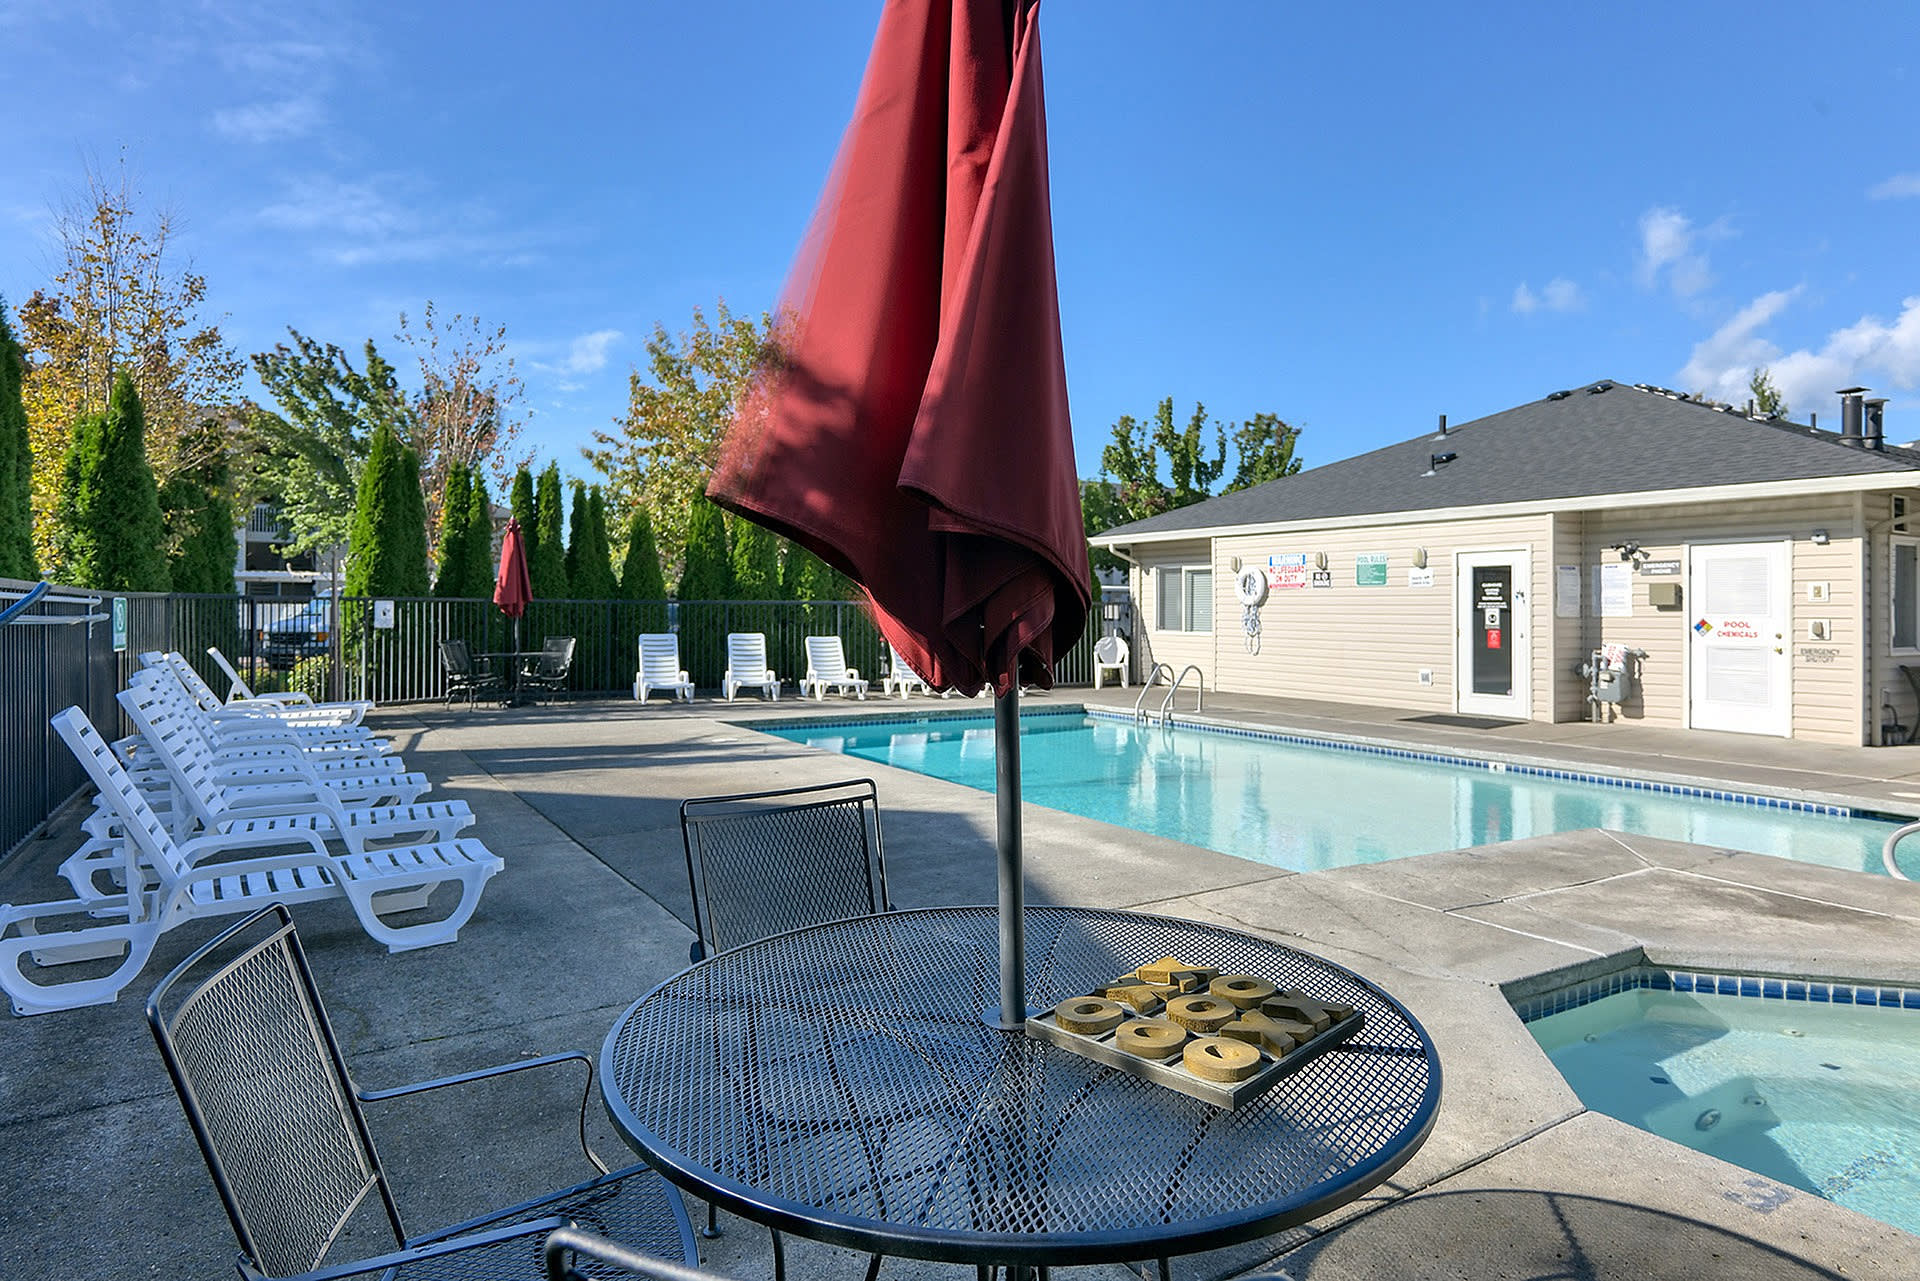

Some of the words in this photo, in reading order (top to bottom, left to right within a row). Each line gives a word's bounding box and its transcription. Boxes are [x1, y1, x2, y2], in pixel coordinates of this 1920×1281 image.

[1357, 555, 1369, 563] POOL
[1370, 554, 1386, 563] RULES
[1277, 565, 1304, 574] LIFEGUARD
[1284, 574, 1297, 582] DUTY
[1723, 621, 1751, 629] POOL
[1800, 648, 1840, 656] EMERGENCY
